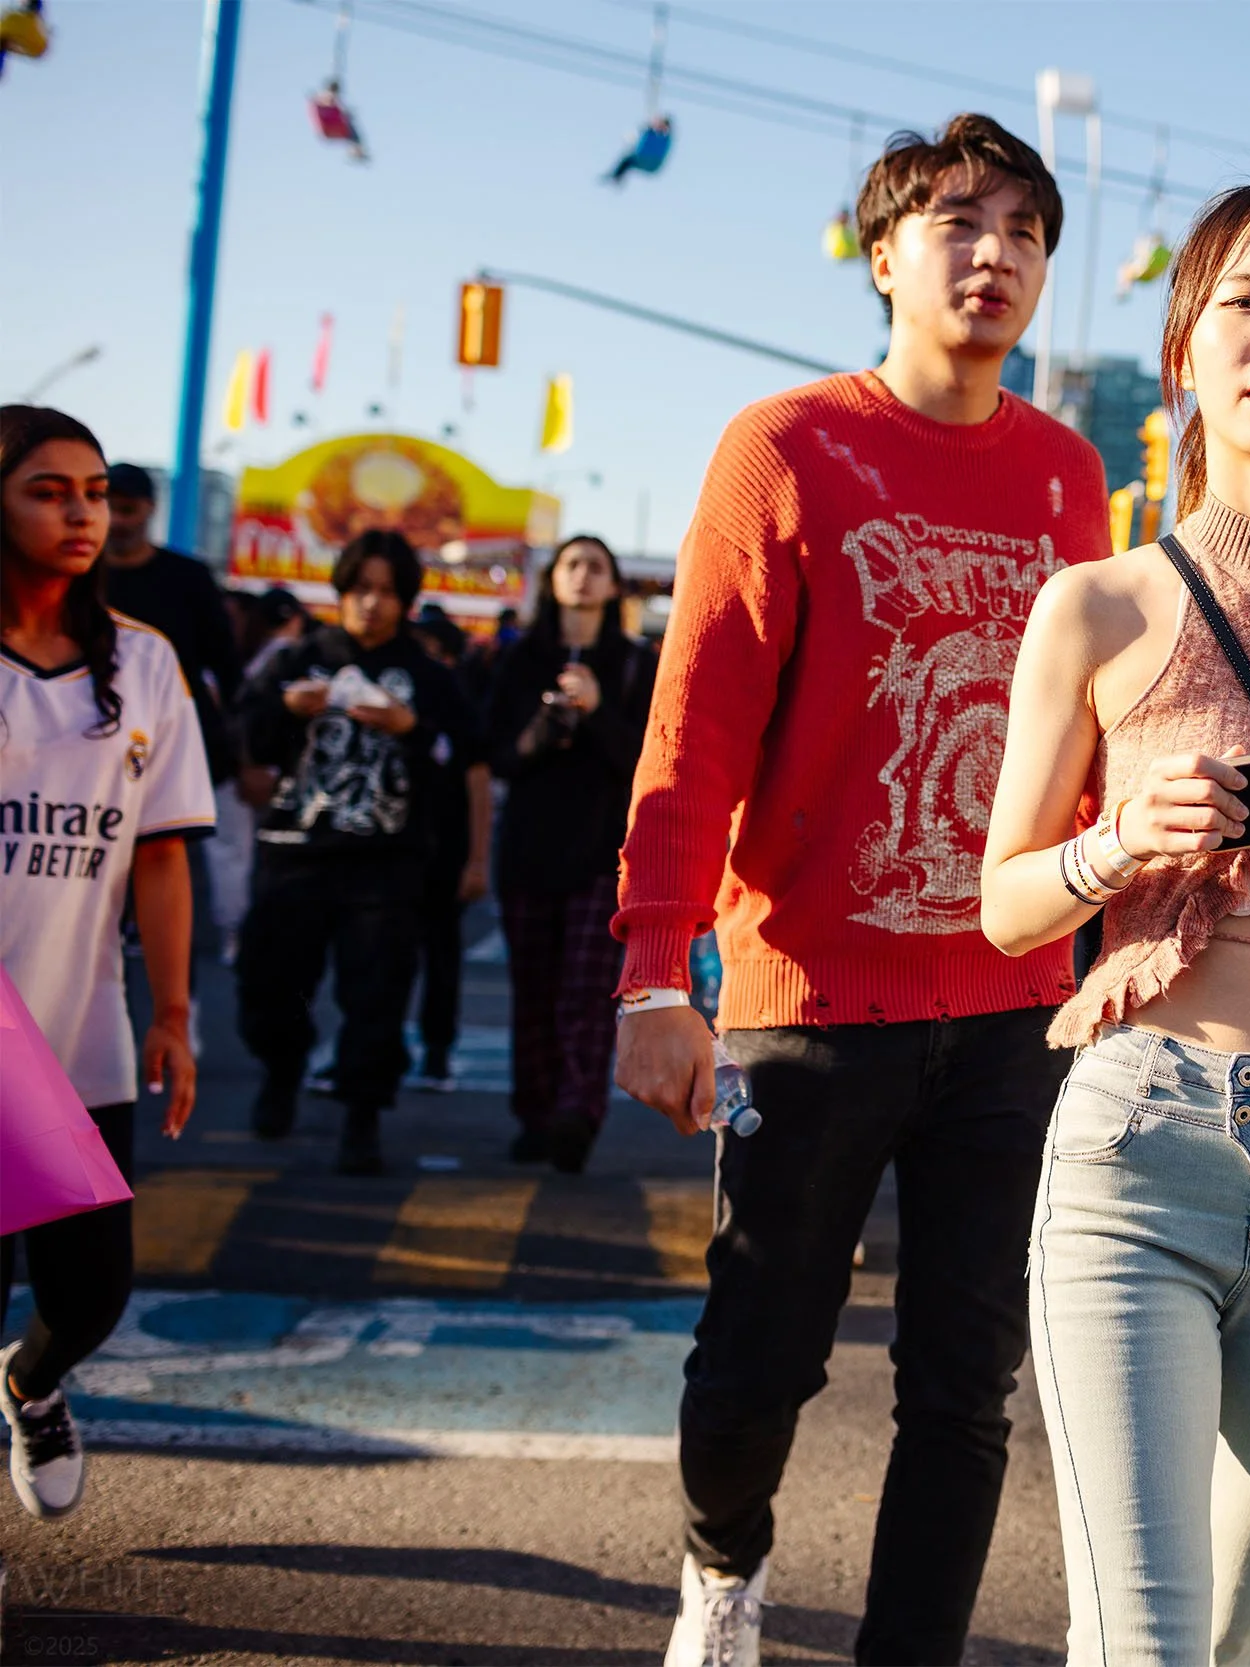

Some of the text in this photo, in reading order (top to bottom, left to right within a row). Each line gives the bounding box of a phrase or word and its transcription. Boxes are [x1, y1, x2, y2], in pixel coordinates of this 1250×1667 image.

[896, 512, 1035, 555] Dreamers
[841, 518, 1073, 626] Parad
[27, 843, 106, 879] BETR
